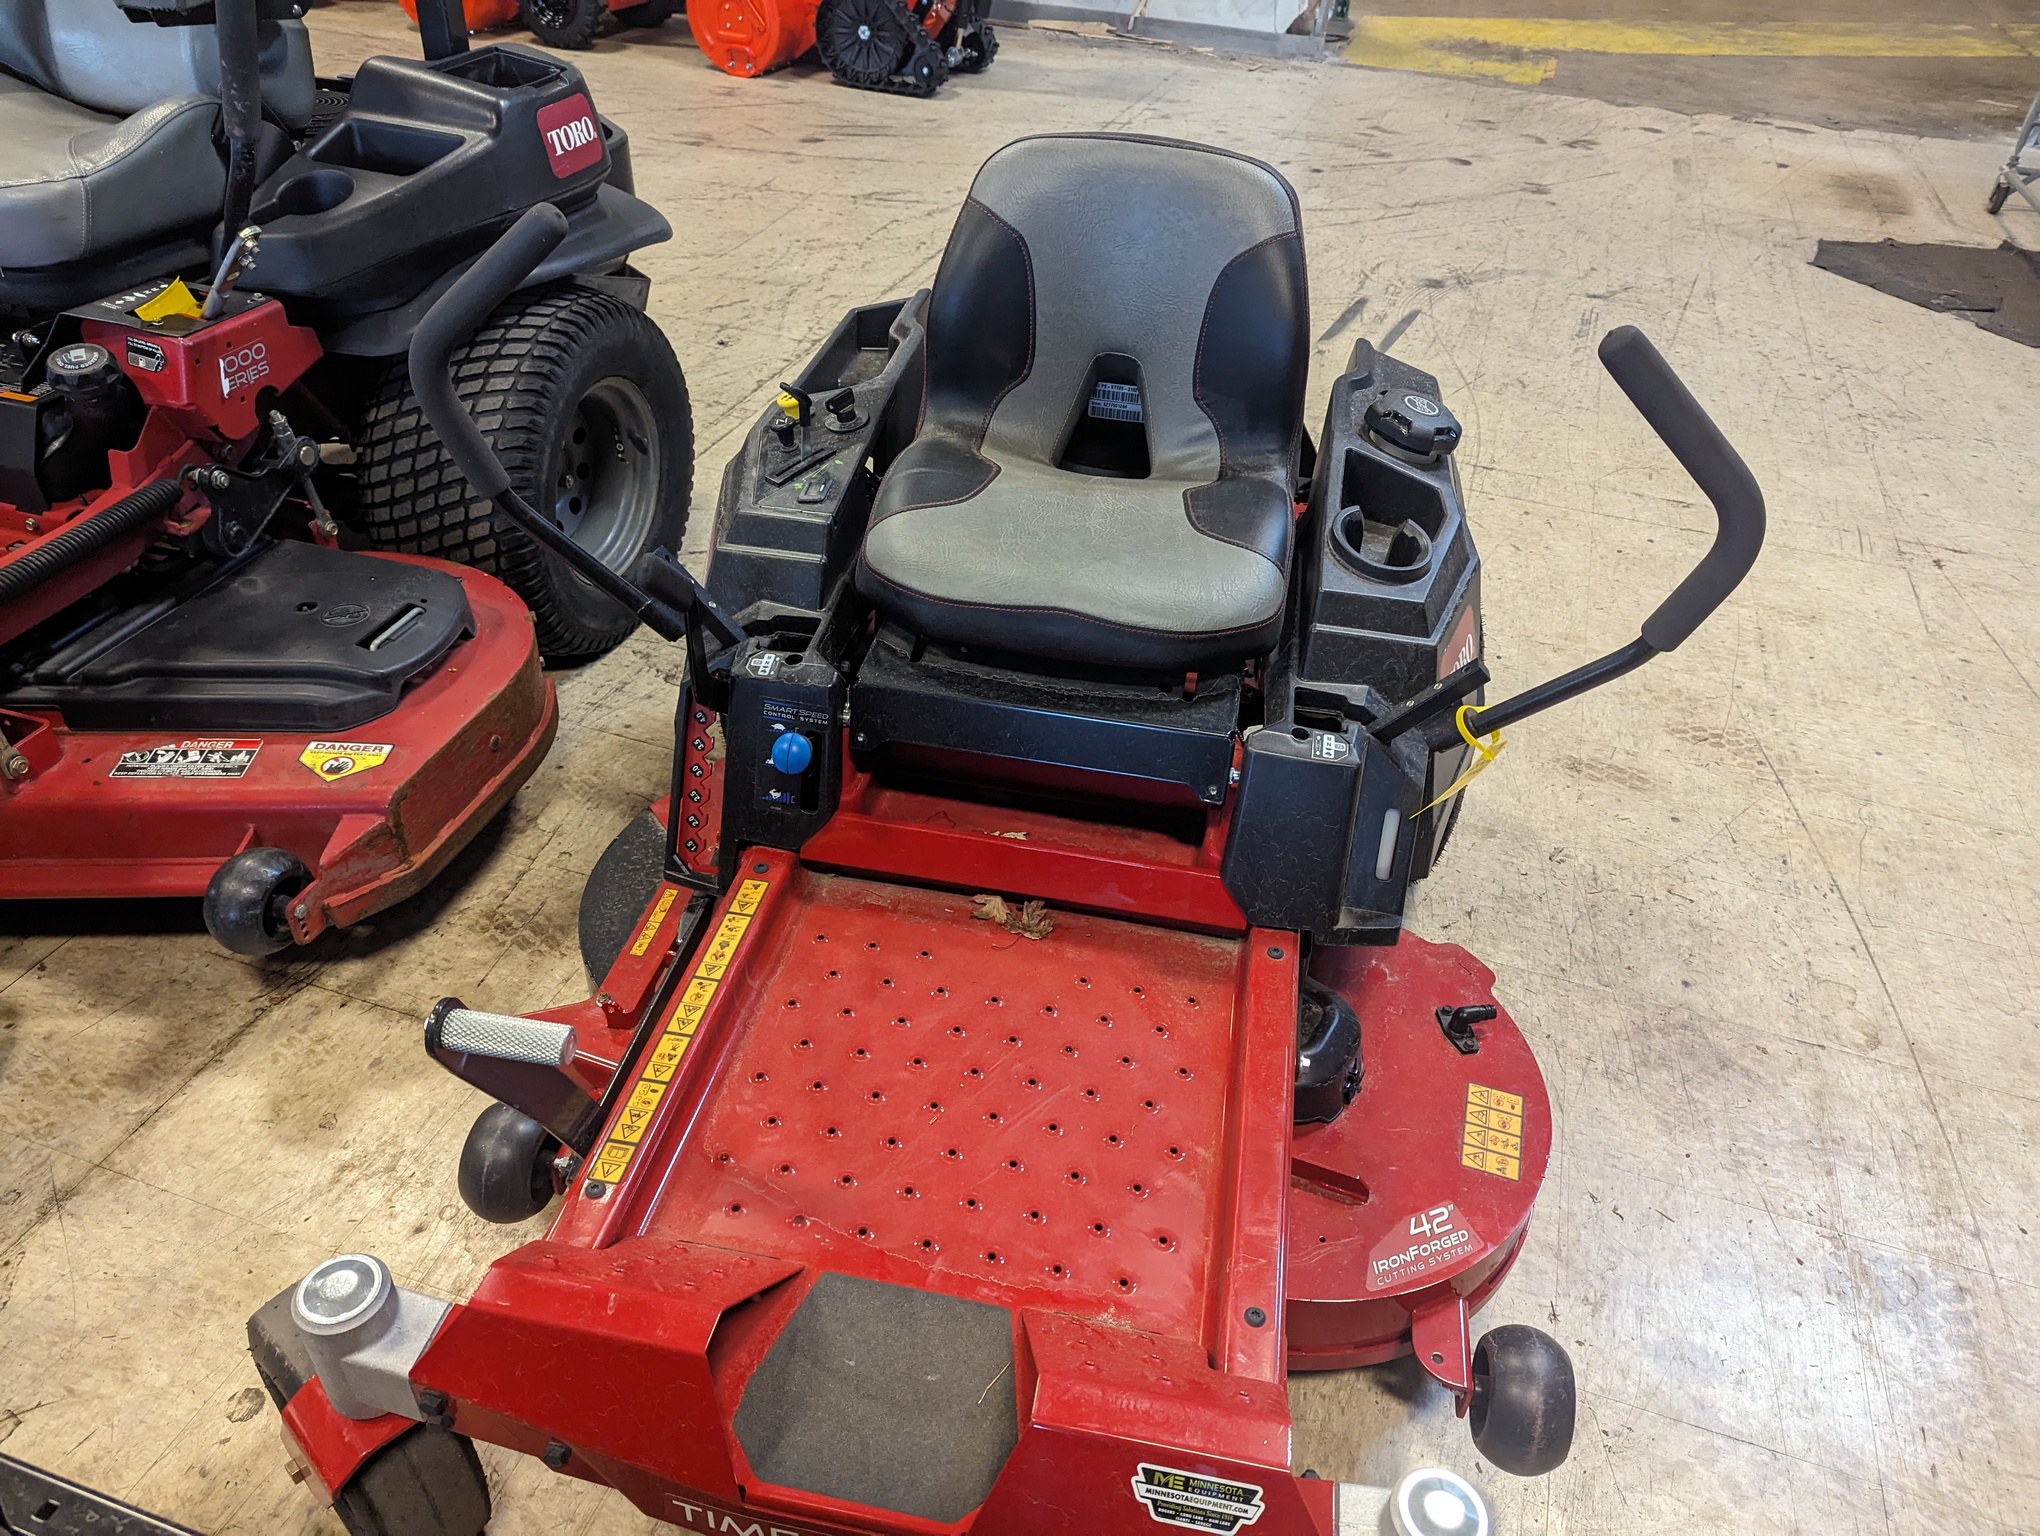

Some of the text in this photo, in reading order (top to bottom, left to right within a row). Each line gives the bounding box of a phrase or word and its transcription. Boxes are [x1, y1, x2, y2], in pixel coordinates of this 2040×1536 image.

[547, 116, 595, 156] TORO
[228, 360, 270, 391] ERIES
[763, 703, 829, 720] SMART SPEED
[763, 710, 829, 726] CONTROL SYSTEM
[180, 741, 235, 749] DANGER
[313, 743, 385, 753] DANGER
[1409, 1204, 1454, 1238] 42"
[1377, 1243, 1474, 1286] CUTTING SYSTEM
[1188, 1486, 1244, 1503] EQUIPMENT
[1189, 1478, 1244, 1497] MINNESOTA
[1145, 1487, 1249, 1515] MINNESOTAEQUIPMENT.COM
